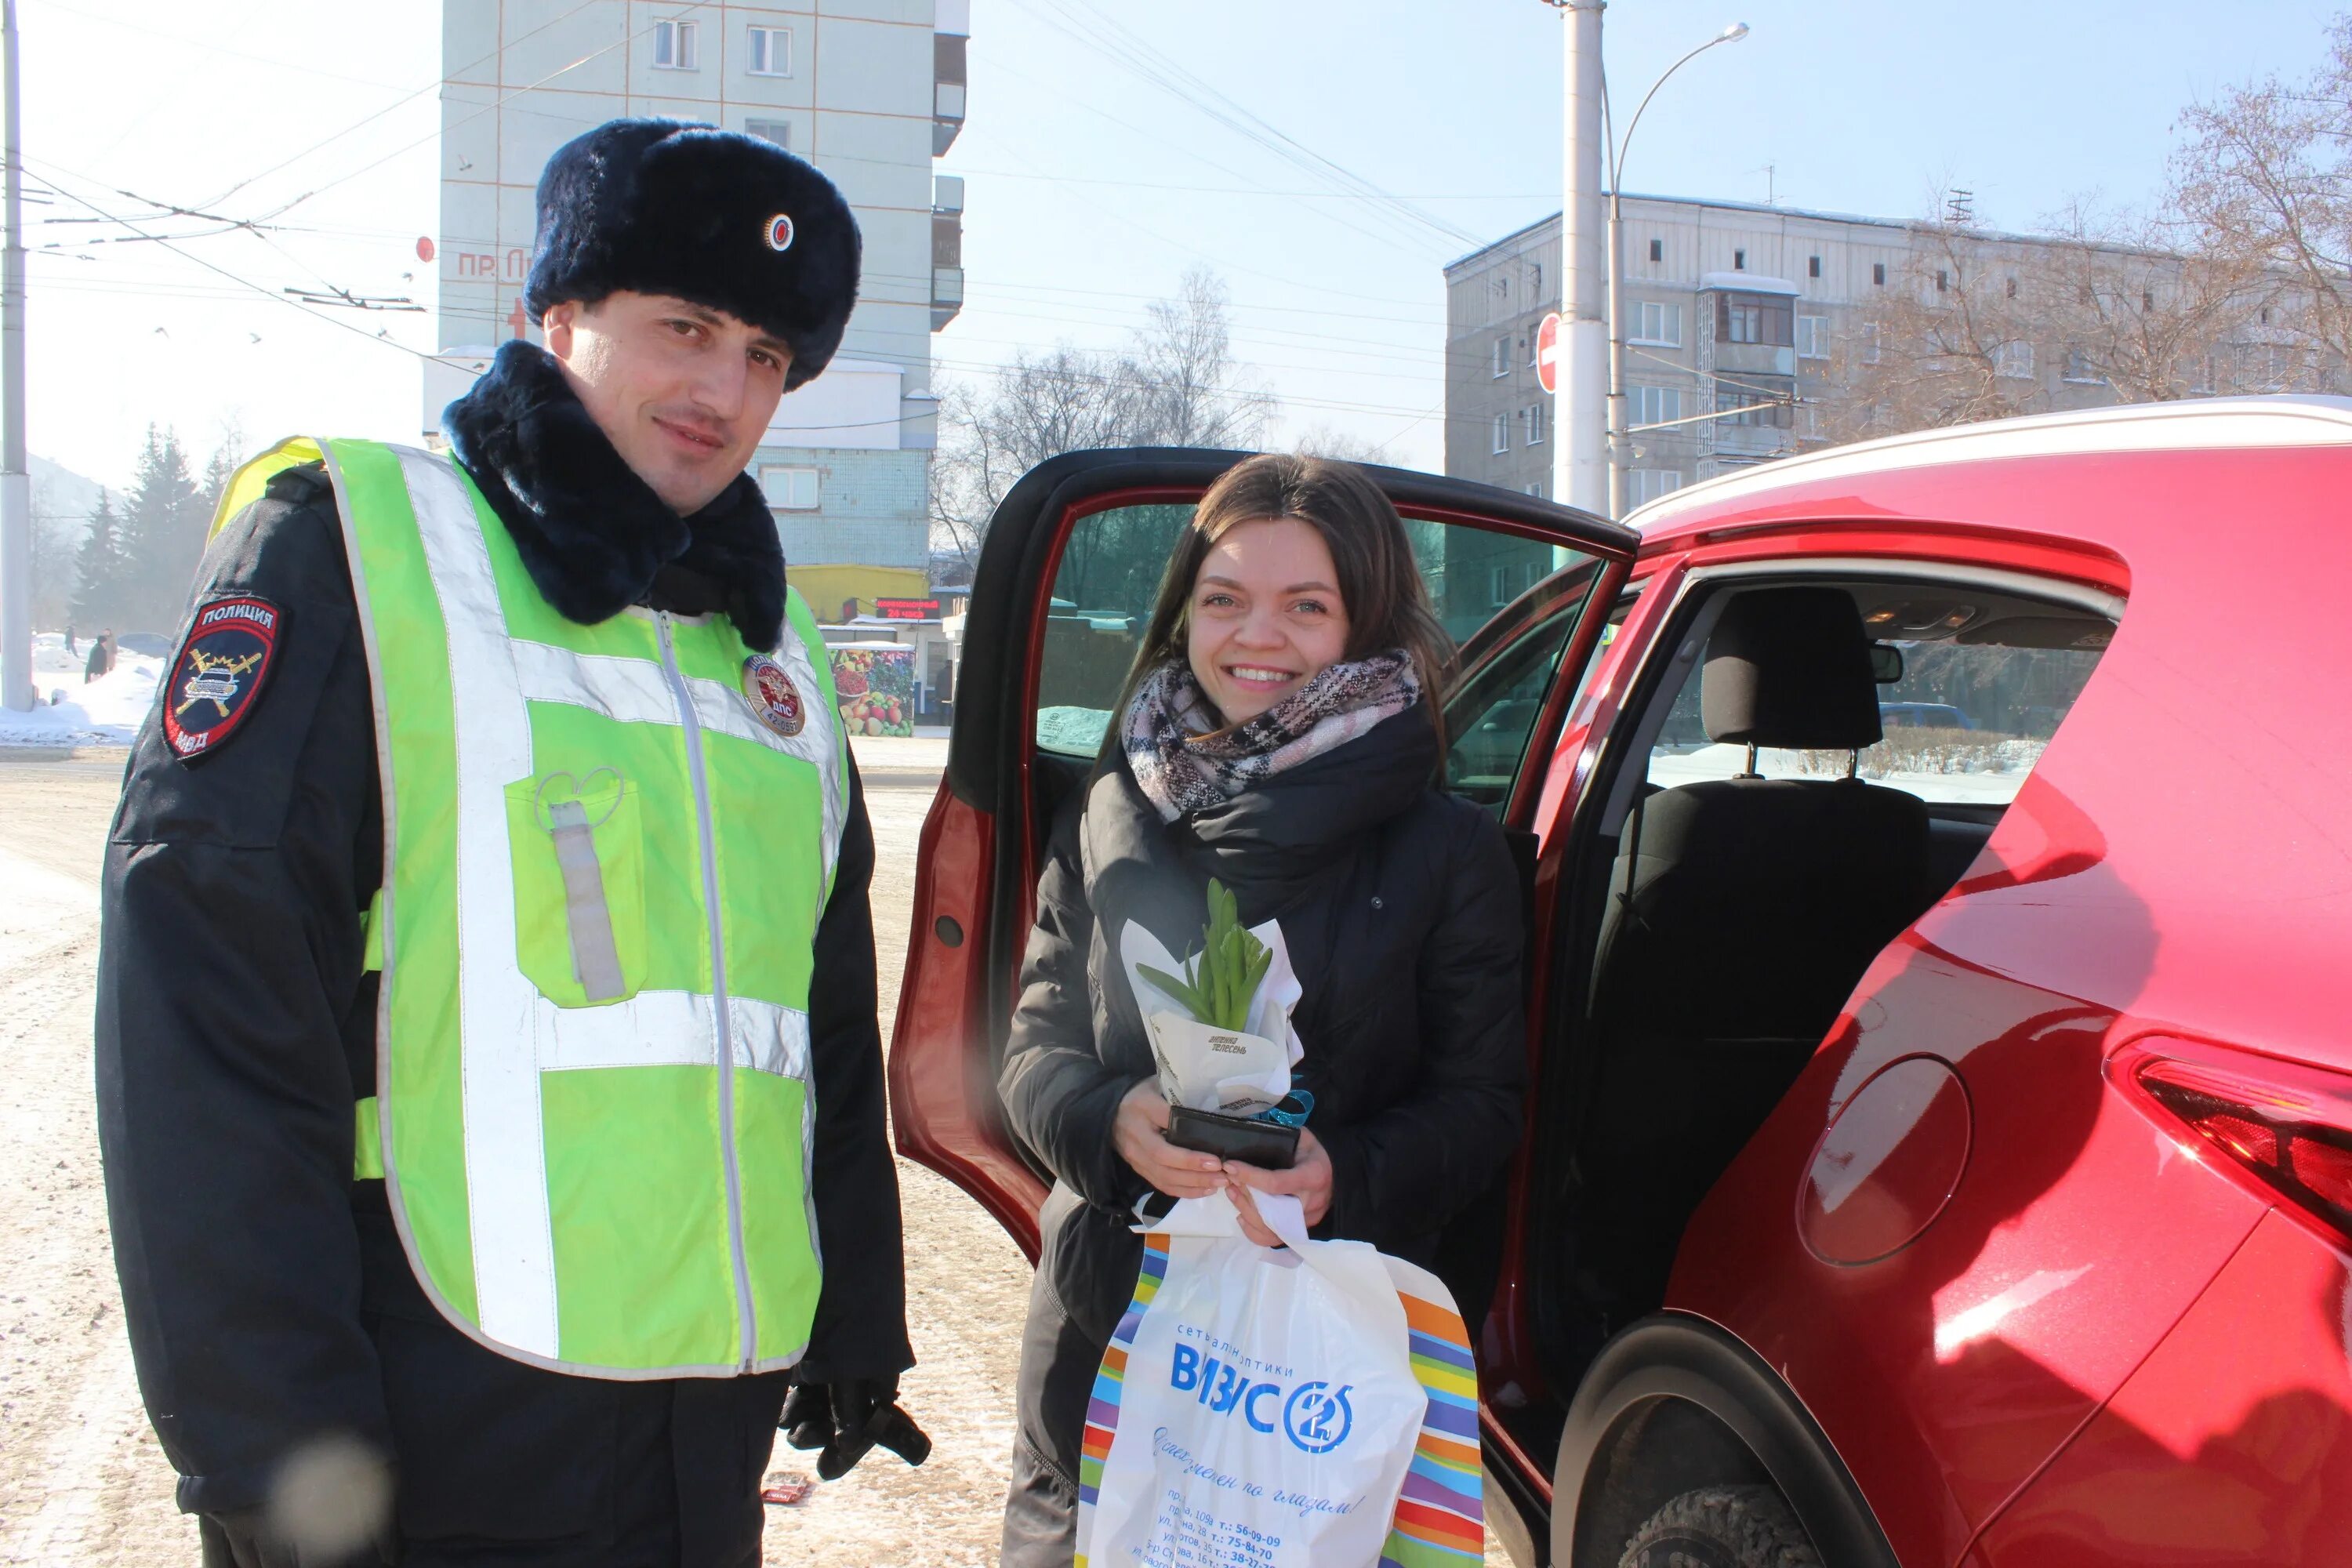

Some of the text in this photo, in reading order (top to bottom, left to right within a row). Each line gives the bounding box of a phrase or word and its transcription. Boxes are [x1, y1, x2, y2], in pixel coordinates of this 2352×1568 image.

[201, 604, 274, 630] ПОЛИЦИЯ
[772, 700, 793, 717] ДПС
[176, 731, 209, 753] МВД
[1178, 1323, 1212, 1341] сеть
[1243, 1481, 1263, 1497] по
[1273, 1490, 1366, 1518] глазам!
[1163, 1532, 1174, 1544] ул
[1169, 1504, 1179, 1515] пр
[1228, 1536, 1272, 1560] 75-84-70
[1236, 1523, 1280, 1547] 56-09-09
